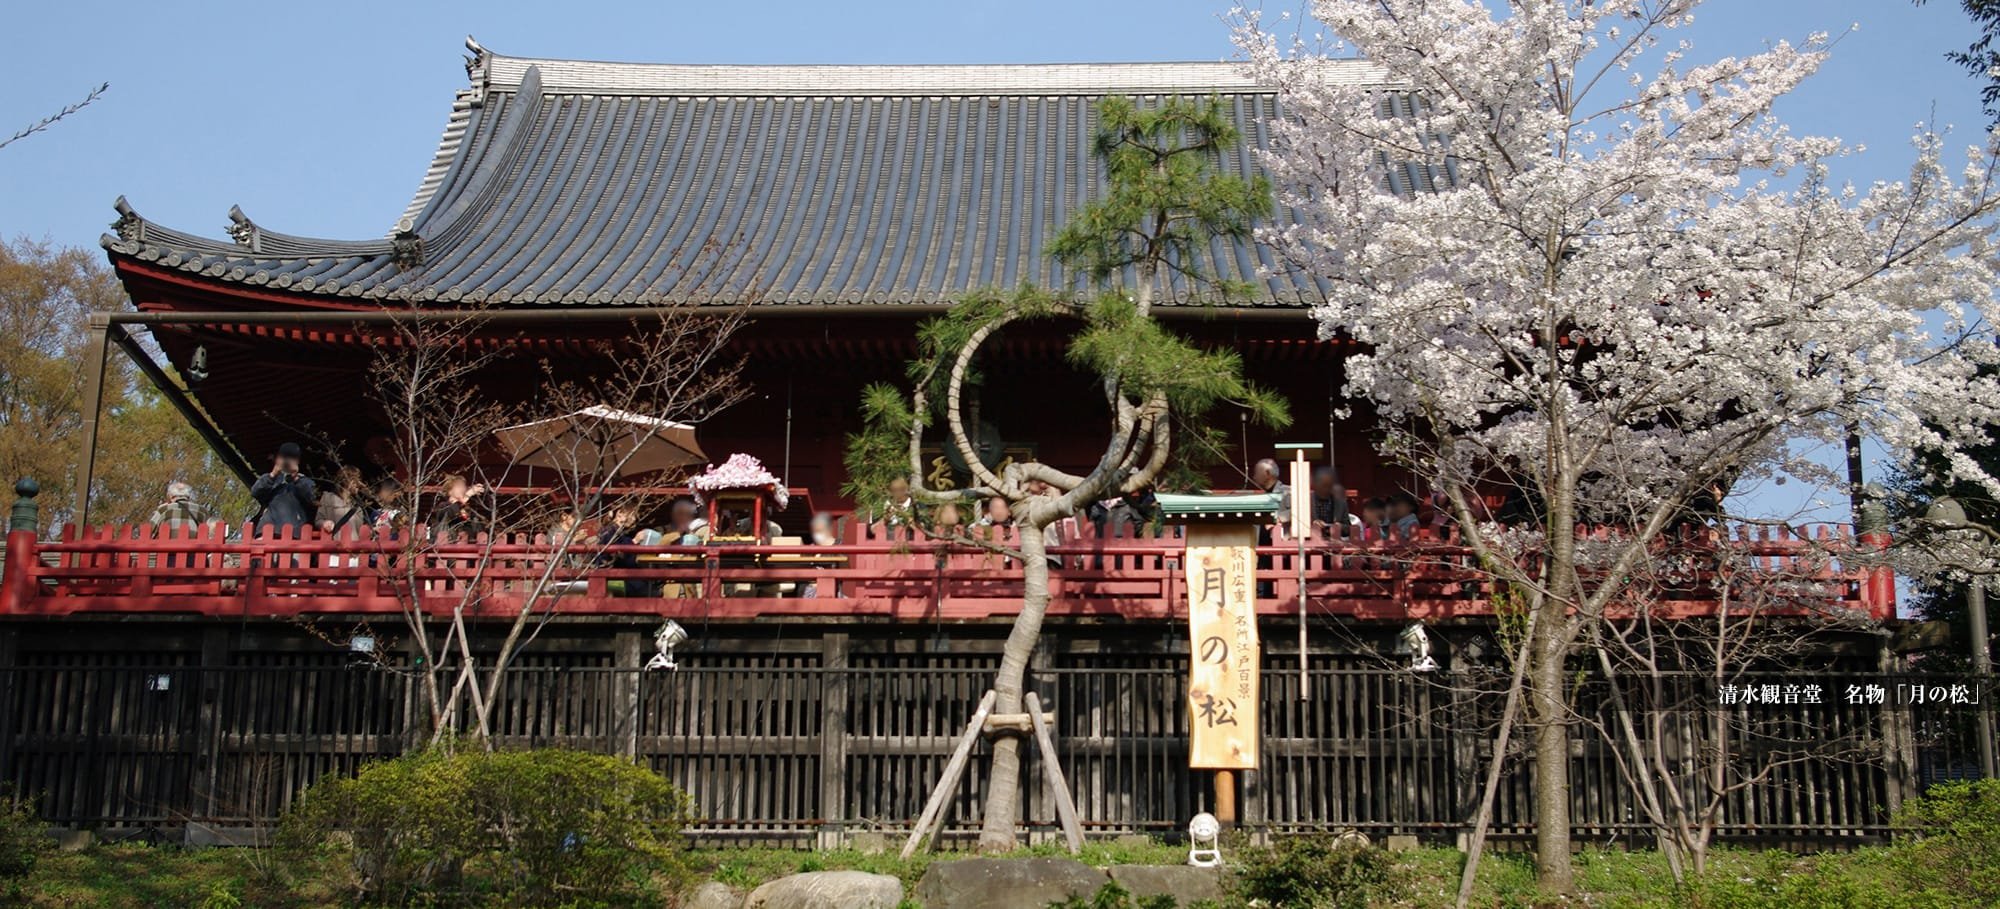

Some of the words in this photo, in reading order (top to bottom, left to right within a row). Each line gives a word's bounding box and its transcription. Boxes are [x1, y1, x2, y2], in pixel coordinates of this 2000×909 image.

[1199, 567, 1238, 729] 月の松
[1234, 615, 1251, 699] 名所江戸百景
